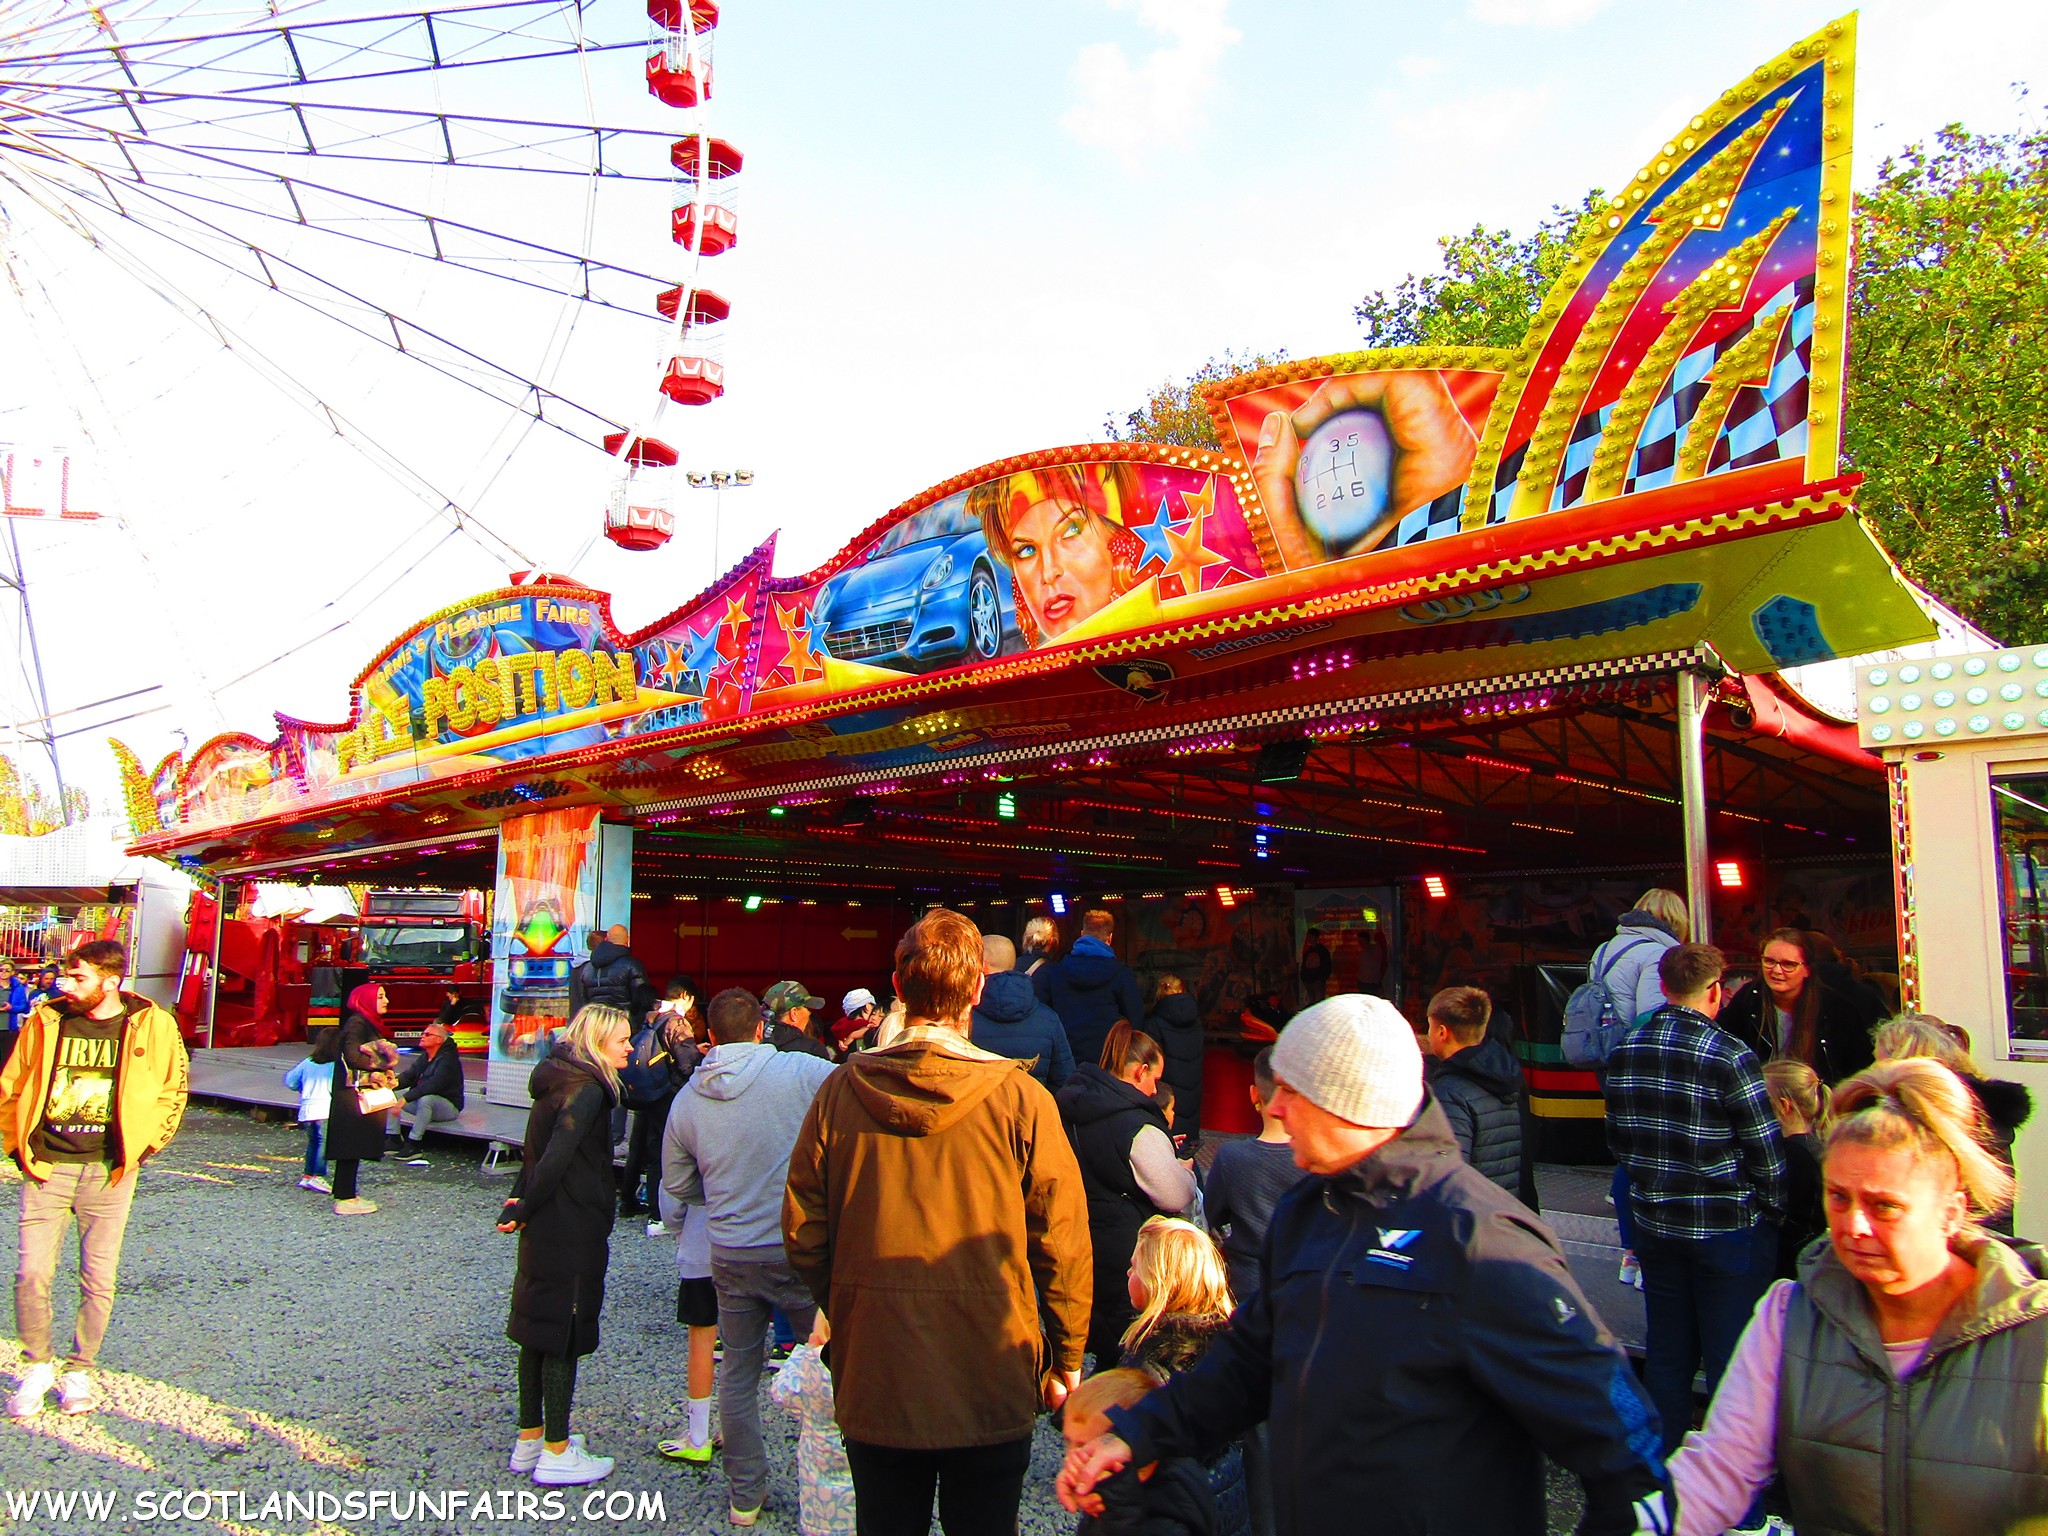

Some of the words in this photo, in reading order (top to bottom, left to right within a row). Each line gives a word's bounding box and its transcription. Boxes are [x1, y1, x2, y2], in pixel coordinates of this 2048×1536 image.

[1328, 438, 1341, 453] 3
[1346, 432, 1359, 447] 5
[1315, 493, 1327, 510] 2
[1331, 485, 1345, 501] 4
[1350, 480, 1365, 498] 6
[434, 603, 523, 644] PLEASURE
[535, 598, 592, 627] FAIRS
[337, 693, 414, 775] POLE
[421, 648, 639, 740] POSITION
[57, 1036, 120, 1069] IRVA
[68, 1123, 106, 1133] UTERO
